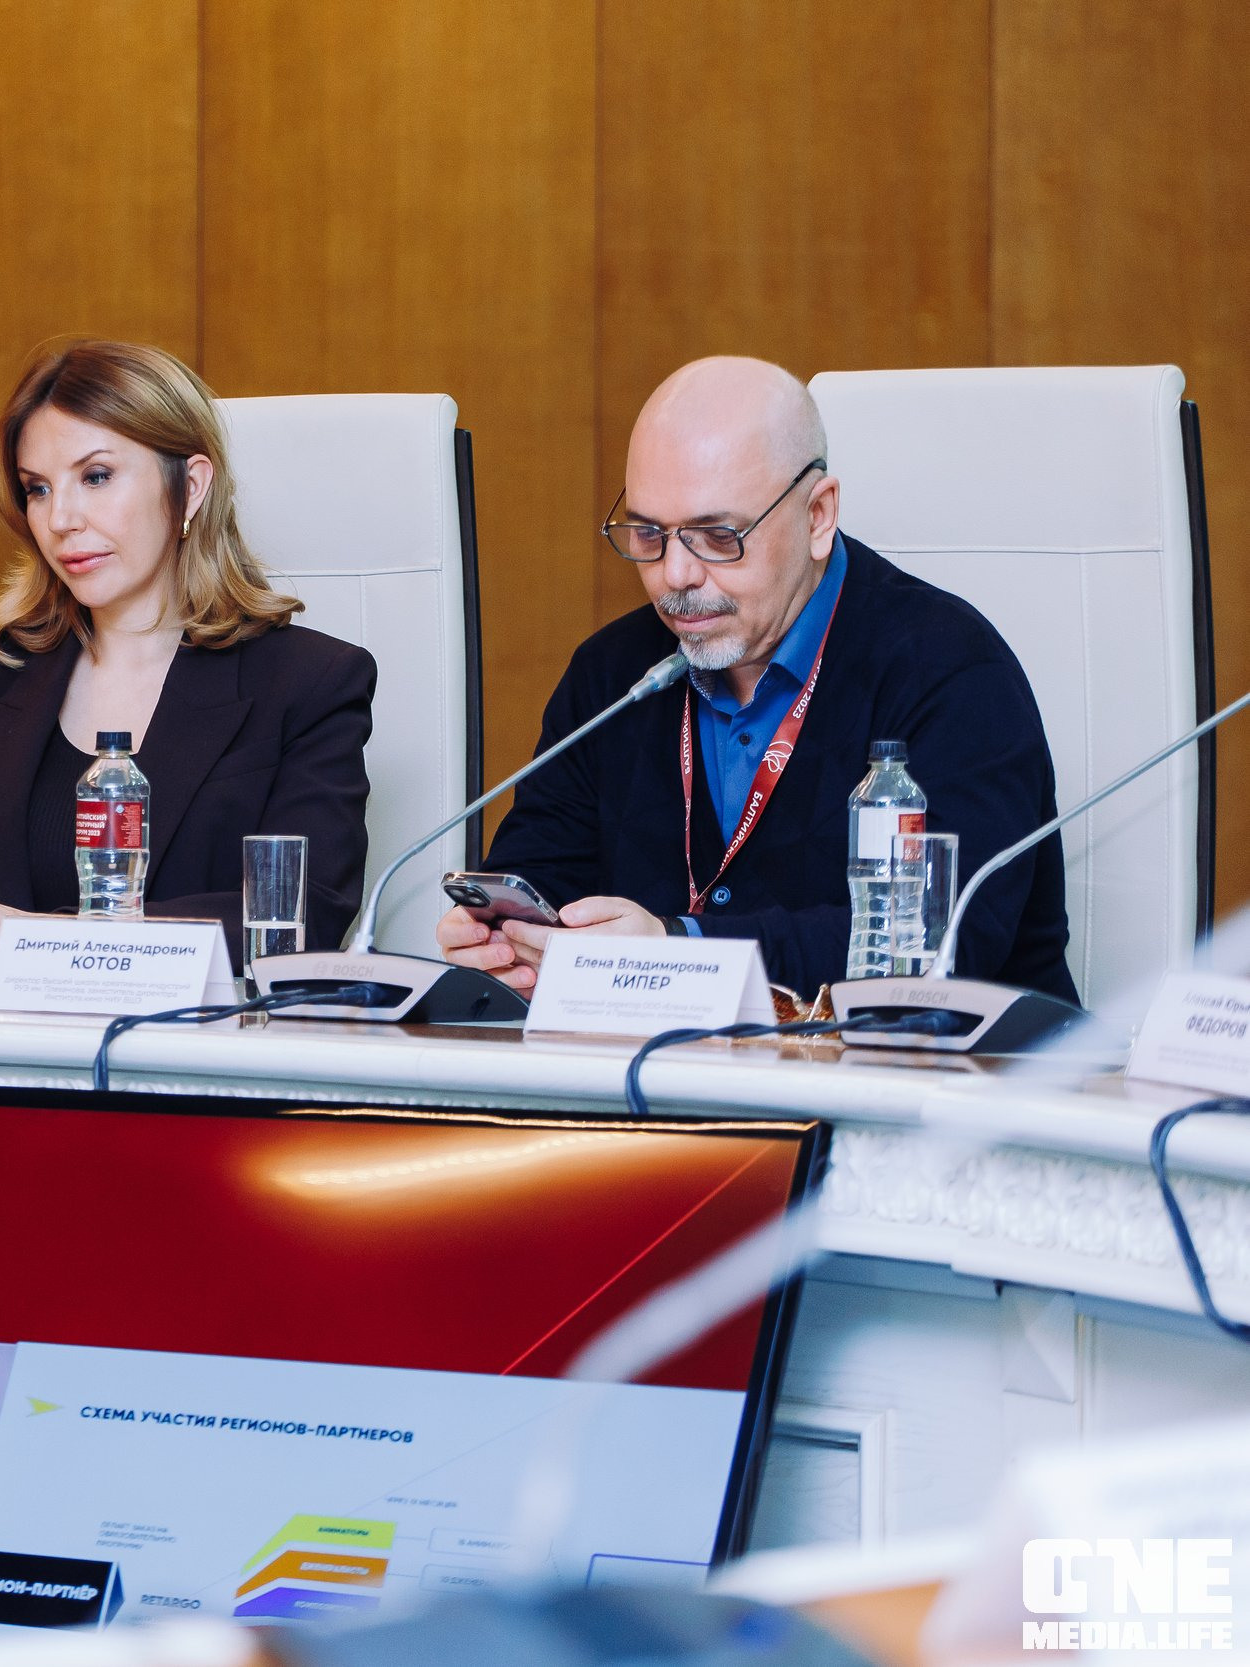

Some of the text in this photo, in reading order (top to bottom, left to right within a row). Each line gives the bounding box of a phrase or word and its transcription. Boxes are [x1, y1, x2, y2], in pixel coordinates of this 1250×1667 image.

[793, 692, 811, 719] 2023
[14, 938, 196, 956] Дмитрий Александрович
[70, 956, 131, 971] КОТОВ
[332, 964, 375, 977] BOSCH
[574, 956, 719, 974] Елена Владимировна
[612, 975, 671, 990] КИПЕР
[907, 990, 950, 1003] BOSCH
[1186, 1014, 1247, 1038] ФЕДОРОВ
[80, 1405, 414, 1444] СХЕМА УЧАСТИЯ РЕГИОНОВ-ПАРТНЕРОВ
[140, 1594, 201, 1610] RETARGO
